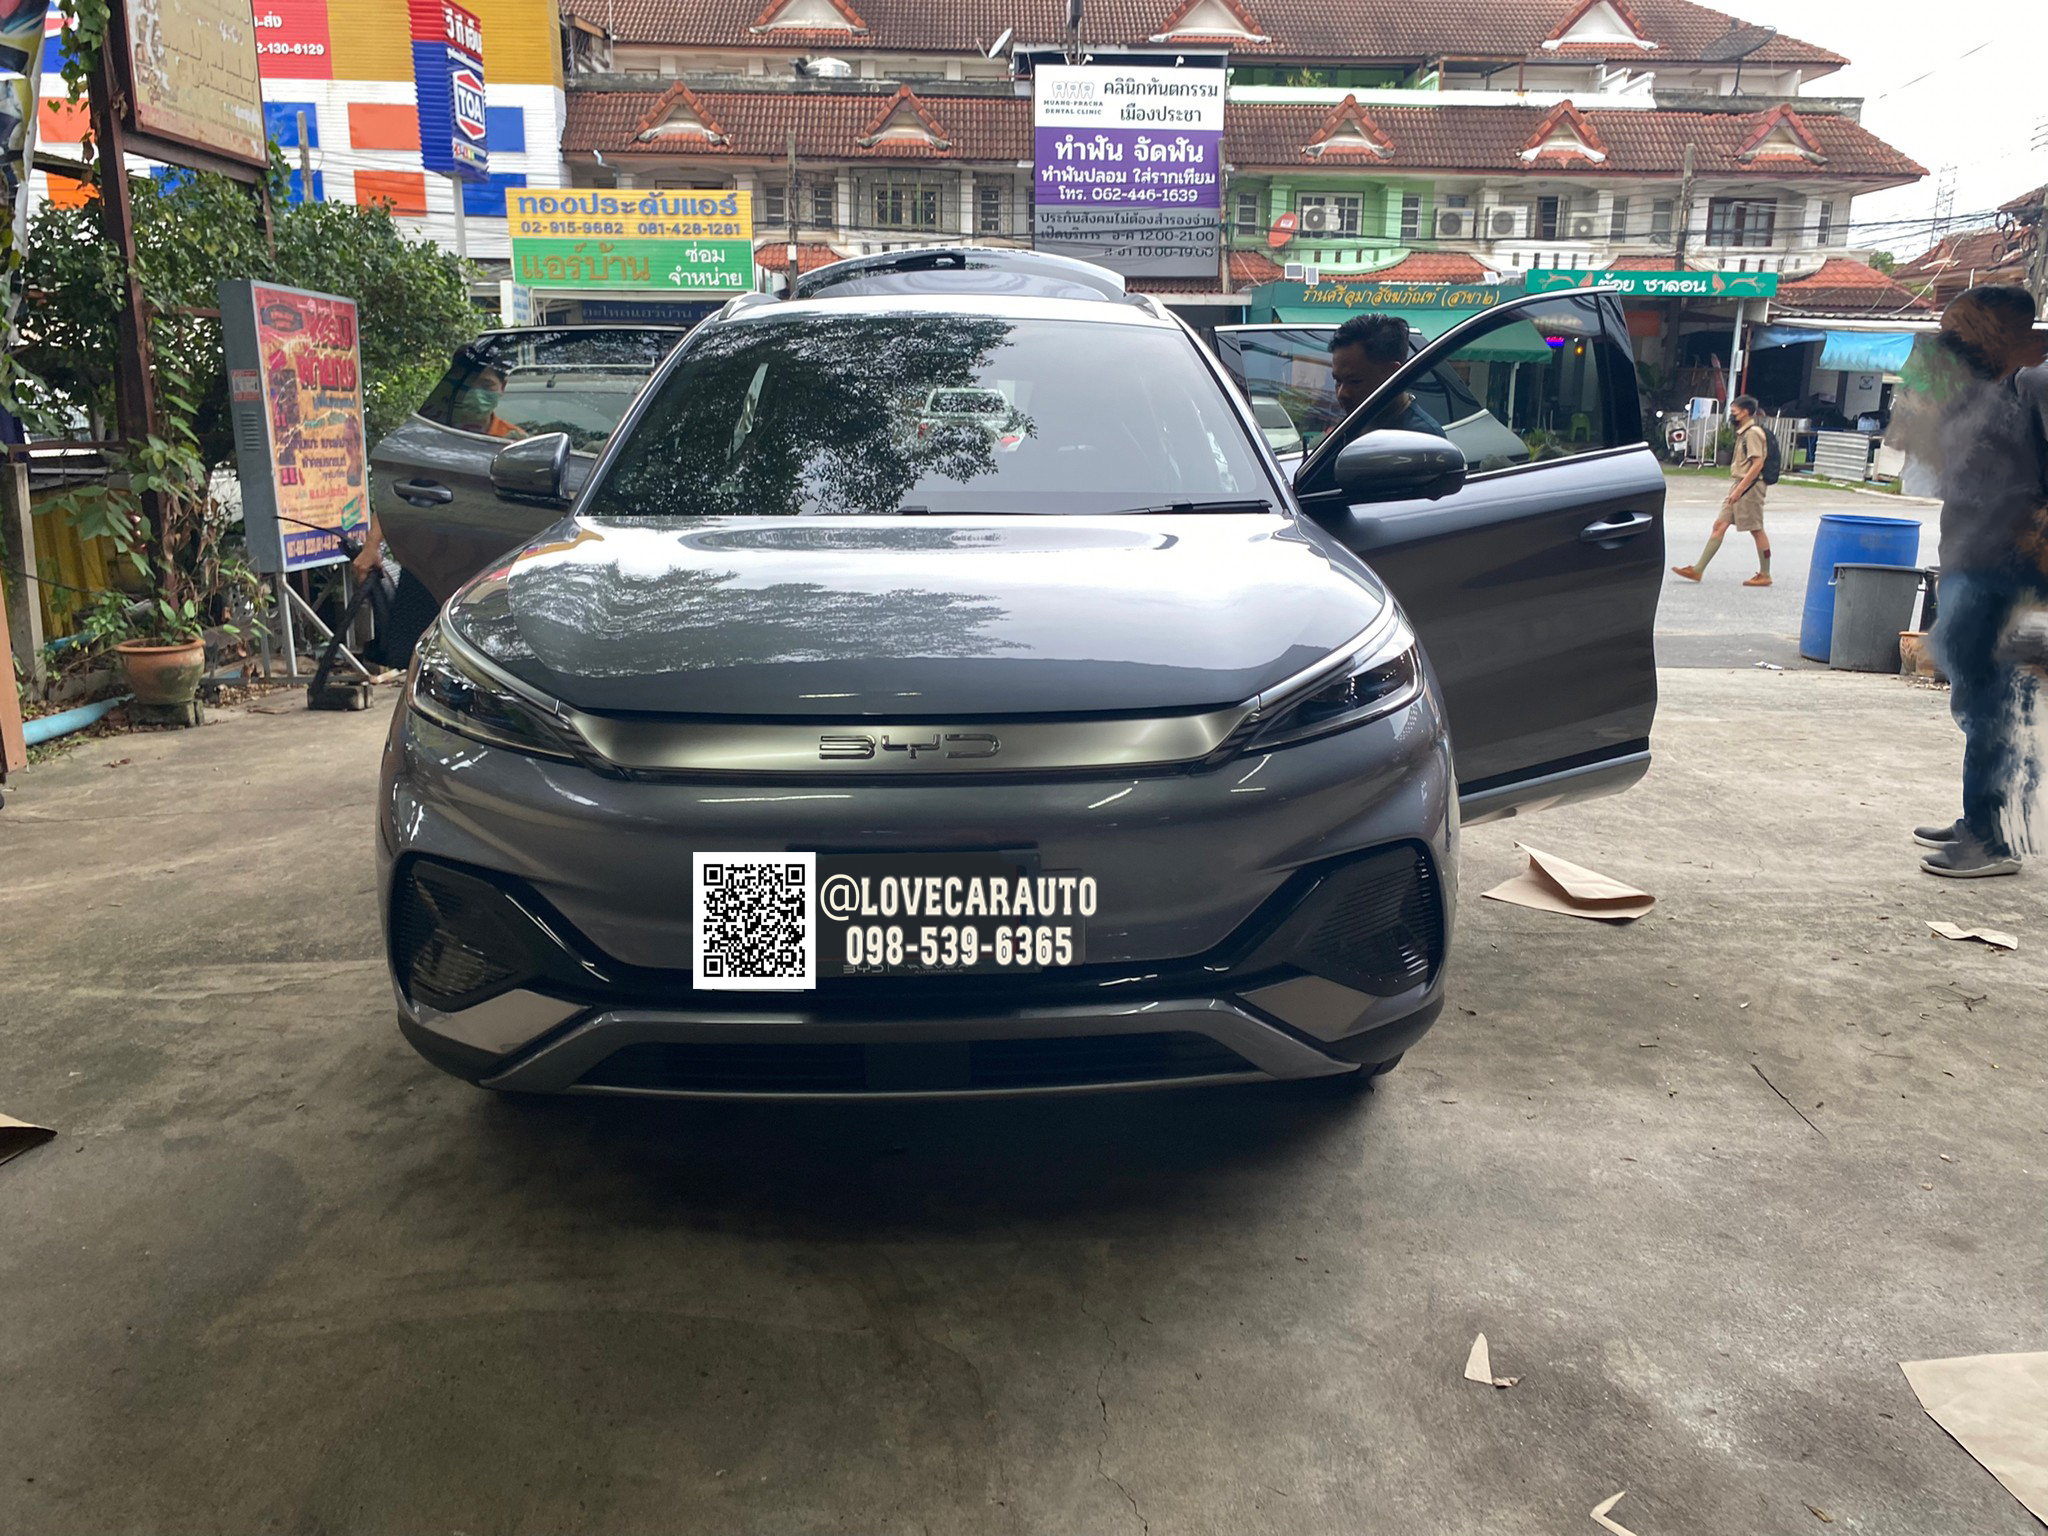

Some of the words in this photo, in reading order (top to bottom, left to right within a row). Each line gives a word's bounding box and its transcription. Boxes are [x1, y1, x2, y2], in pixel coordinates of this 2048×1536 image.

[1103, 77, 1218, 97] คลินิกทันตกรรม
[458, 88, 483, 123] TOA
[1120, 103, 1202, 122] เมืองประชา
[1055, 134, 1123, 161] ทำฟัน
[1134, 136, 1204, 163] จัดฟัน
[1041, 165, 1127, 184] ทำฟันปลอม
[1133, 166, 1216, 185] ใส่รากเทียม
[517, 191, 738, 216] ทองประดับแอร์
[1058, 186, 1087, 200] โทร.
[1092, 188, 1198, 202] 062-446-1639
[520, 221, 624, 234] 02-915-9682
[637, 222, 740, 236] 081-428-1281
[521, 242, 651, 281] แอร์บ้าน
[685, 241, 725, 264] ซ่อม
[668, 266, 743, 287] จำหน่าย
[818, 733, 1002, 760] BYD
